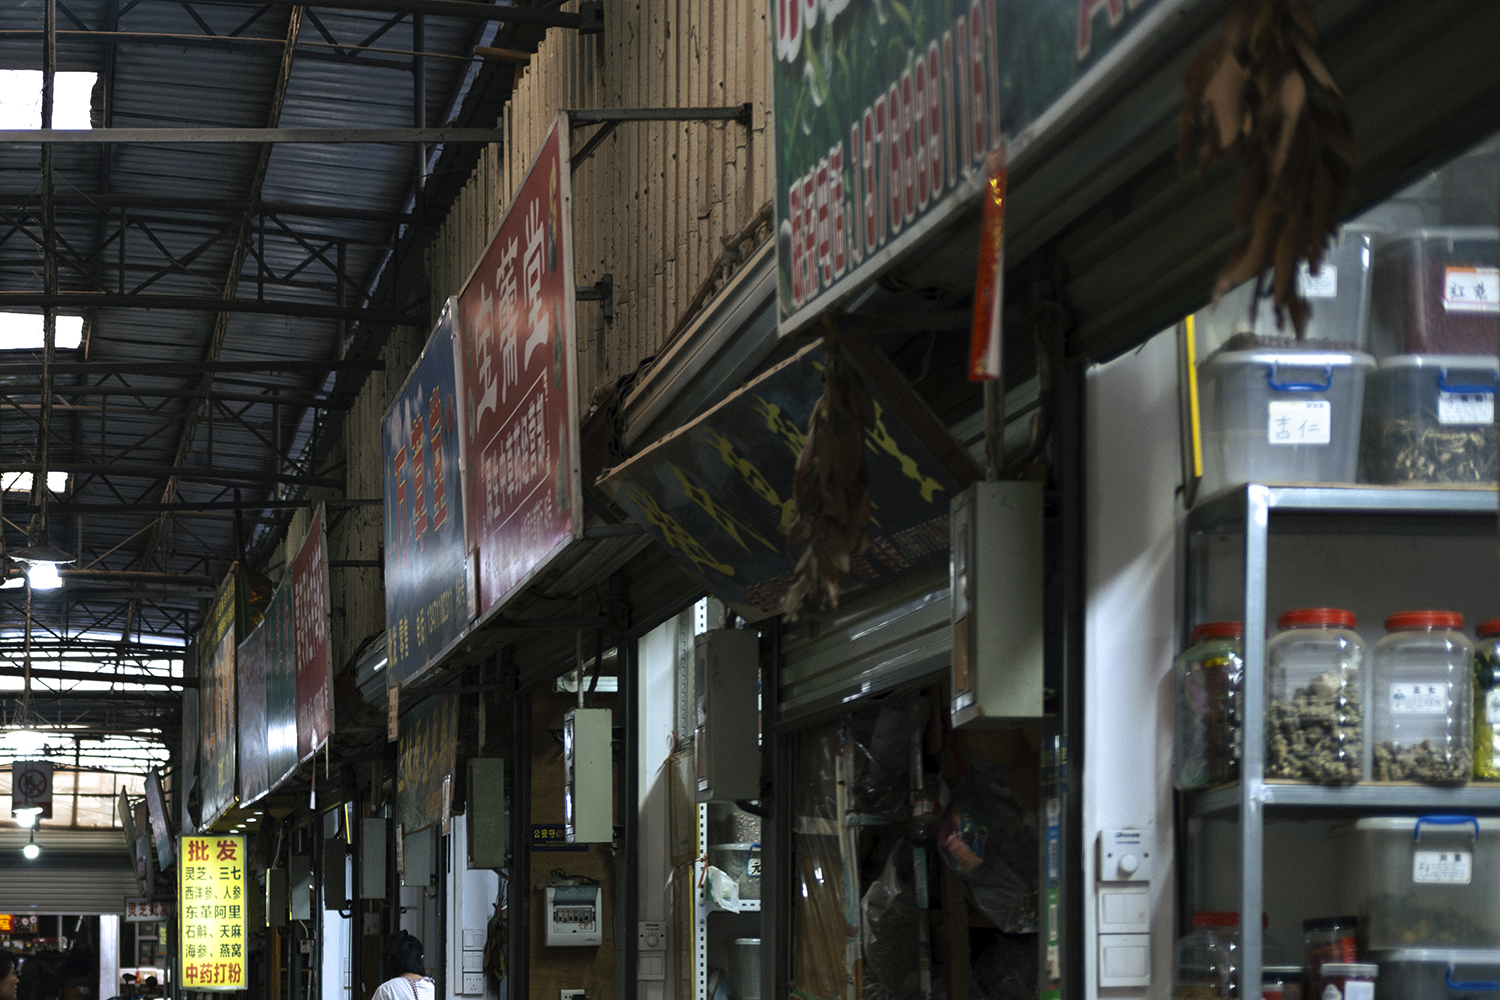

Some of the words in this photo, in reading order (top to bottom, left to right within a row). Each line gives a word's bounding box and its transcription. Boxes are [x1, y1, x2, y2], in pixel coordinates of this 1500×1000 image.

[188, 840, 238, 862] 批发
[185, 905, 241, 919] 东革阿里
[185, 963, 241, 984] 中药打粉
